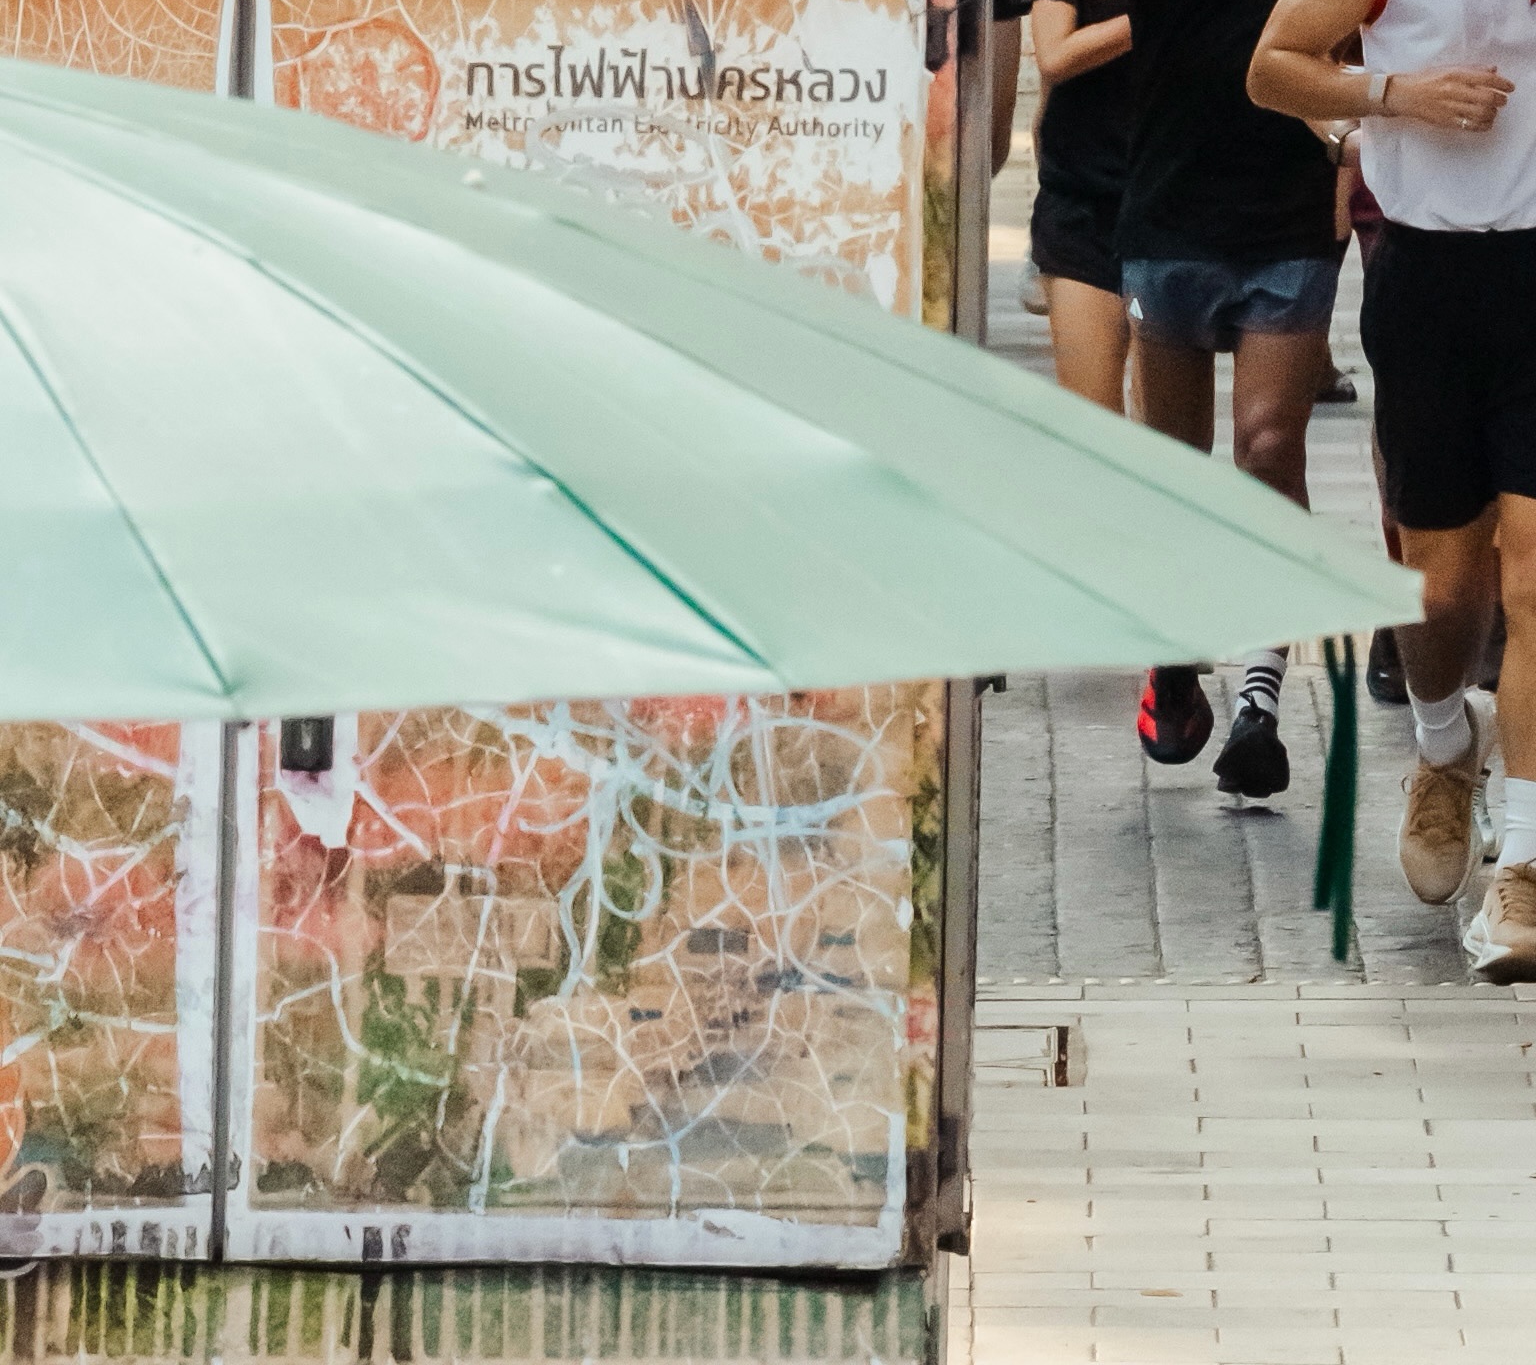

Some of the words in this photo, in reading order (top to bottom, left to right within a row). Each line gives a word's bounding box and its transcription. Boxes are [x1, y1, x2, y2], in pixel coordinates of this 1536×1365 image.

[466, 44, 888, 104] การไฟฟ้านครหลวง
[464, 110, 624, 133] Metrolitan
[767, 116, 886, 144] Authority
